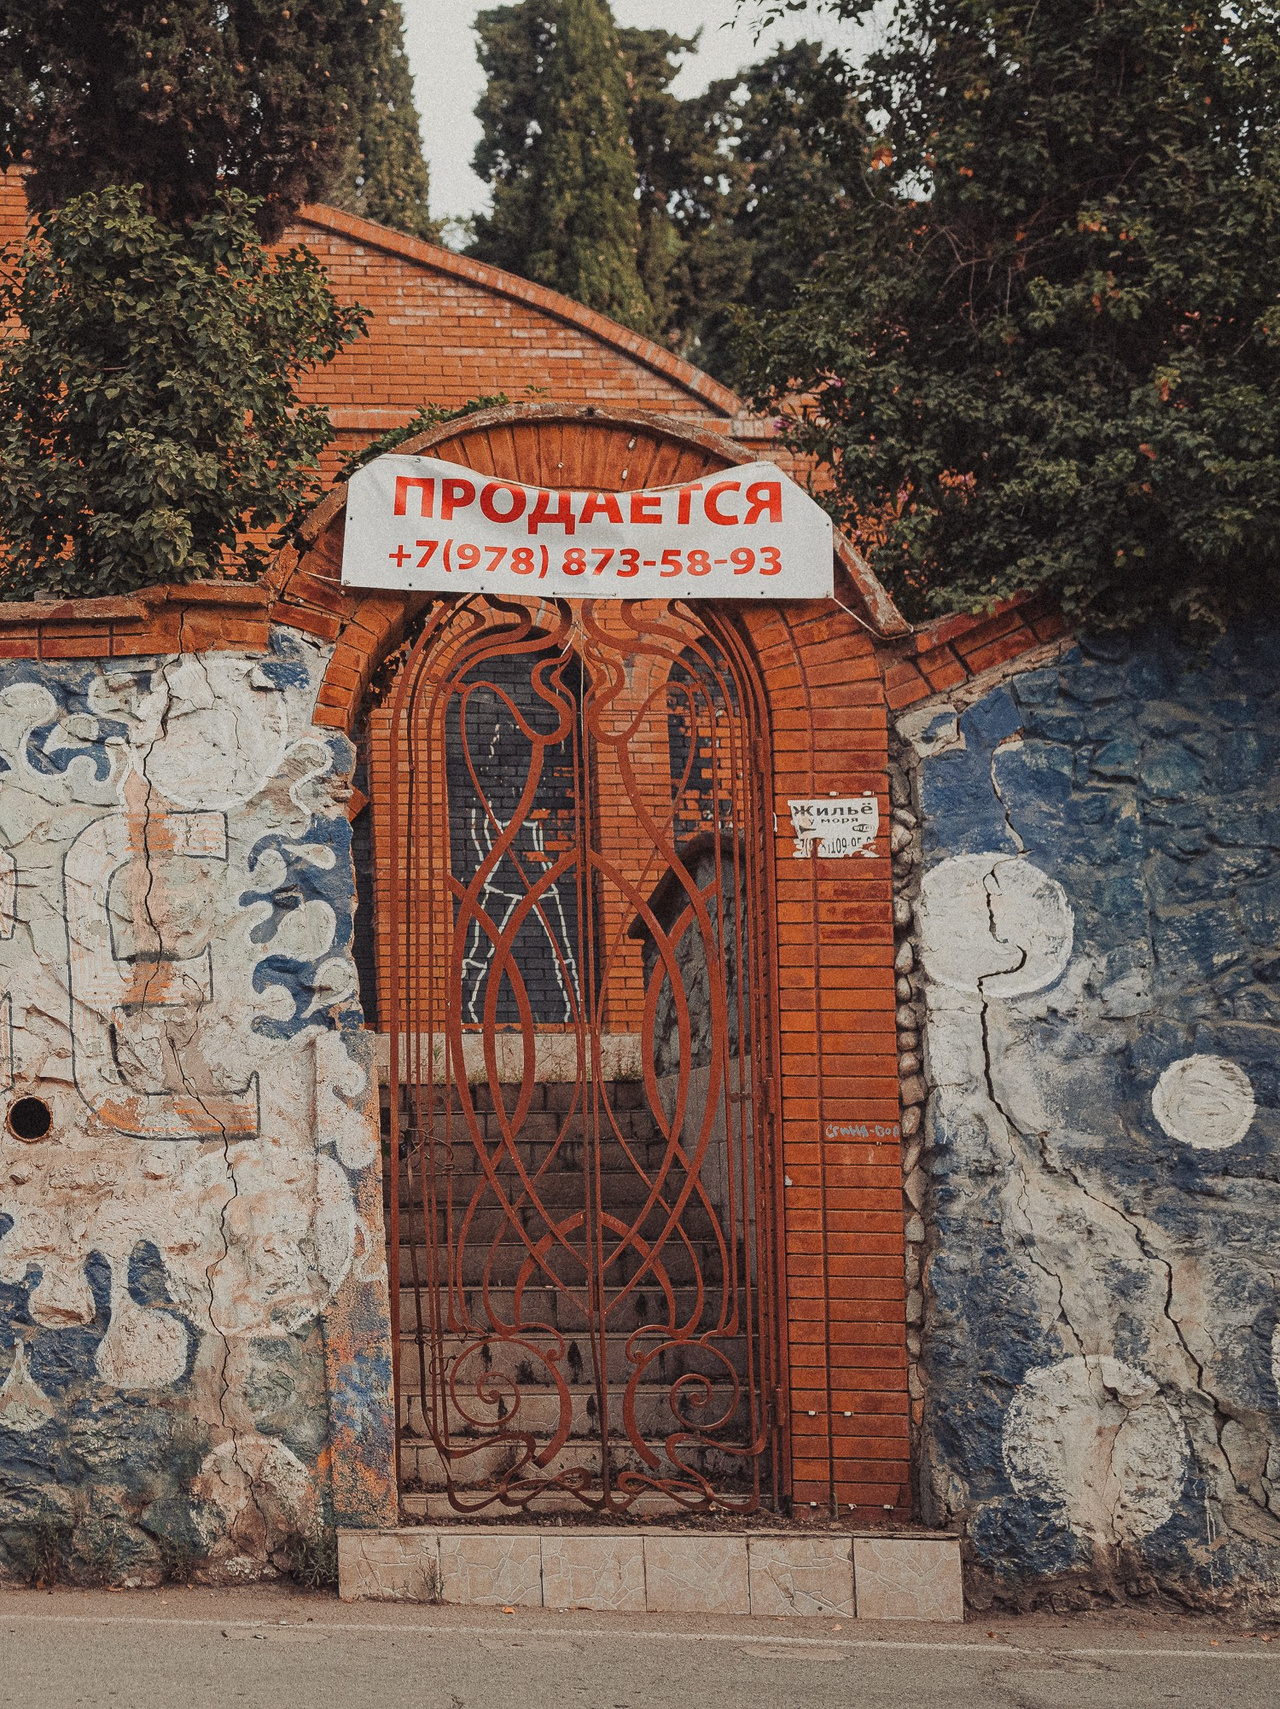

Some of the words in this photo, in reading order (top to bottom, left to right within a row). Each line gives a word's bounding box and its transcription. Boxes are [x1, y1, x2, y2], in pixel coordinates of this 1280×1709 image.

[393, 475, 782, 535] ПРОДАЕТСЯ
[388, 539, 549, 579] +7(978)
[562, 546, 782, 578] 873-58-93
[792, 802, 874, 817] Жильё
[821, 817, 859, 825] моря
